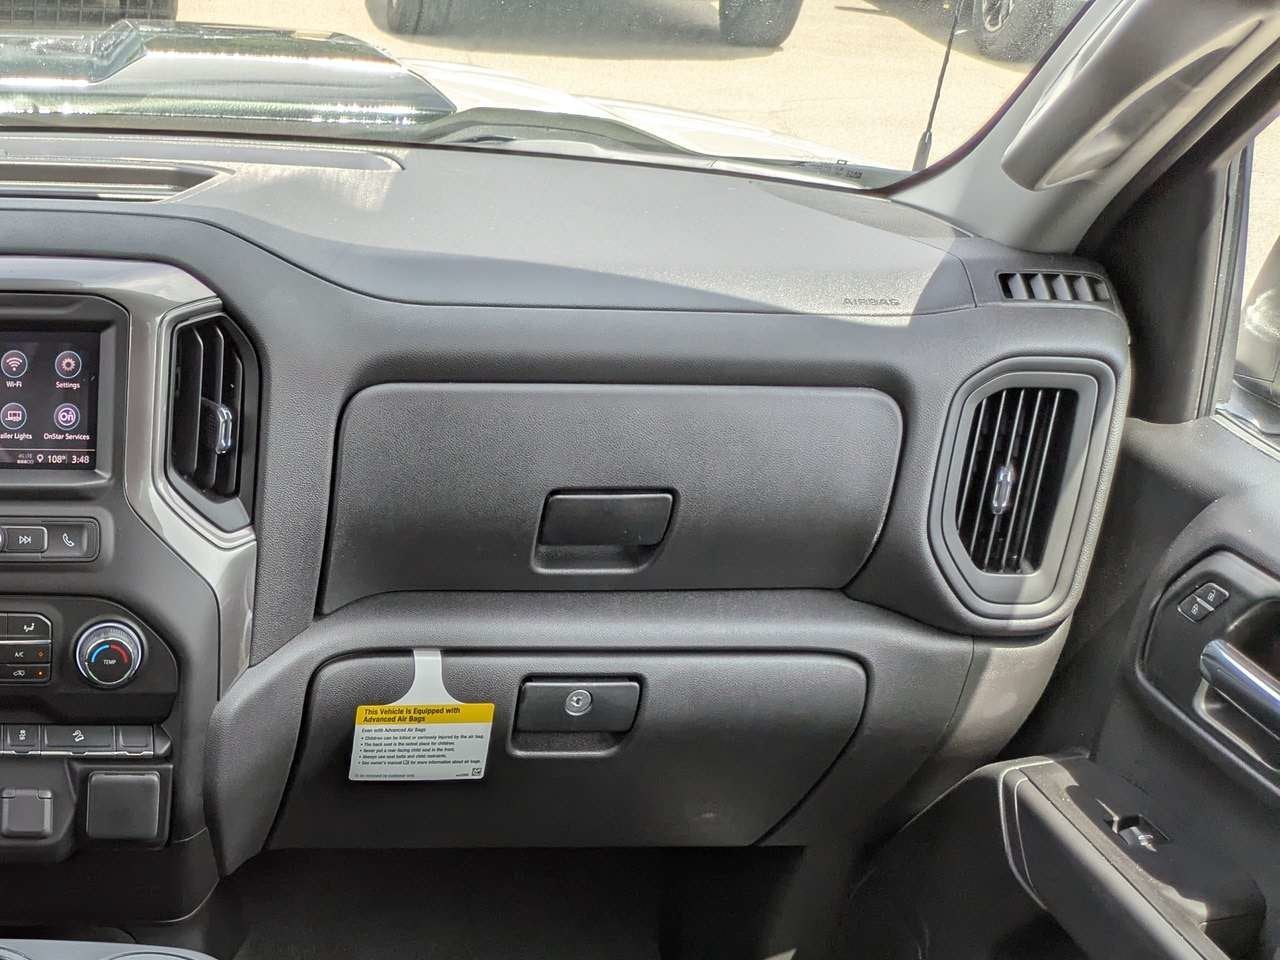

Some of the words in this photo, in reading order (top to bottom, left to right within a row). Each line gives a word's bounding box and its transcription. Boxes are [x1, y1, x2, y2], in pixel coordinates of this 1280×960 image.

[842, 297, 901, 306] AIRBAG
[56, 382, 80, 390] Settings
[72, 456, 90, 464] 3:48
[413, 707, 444, 716] Equipped
